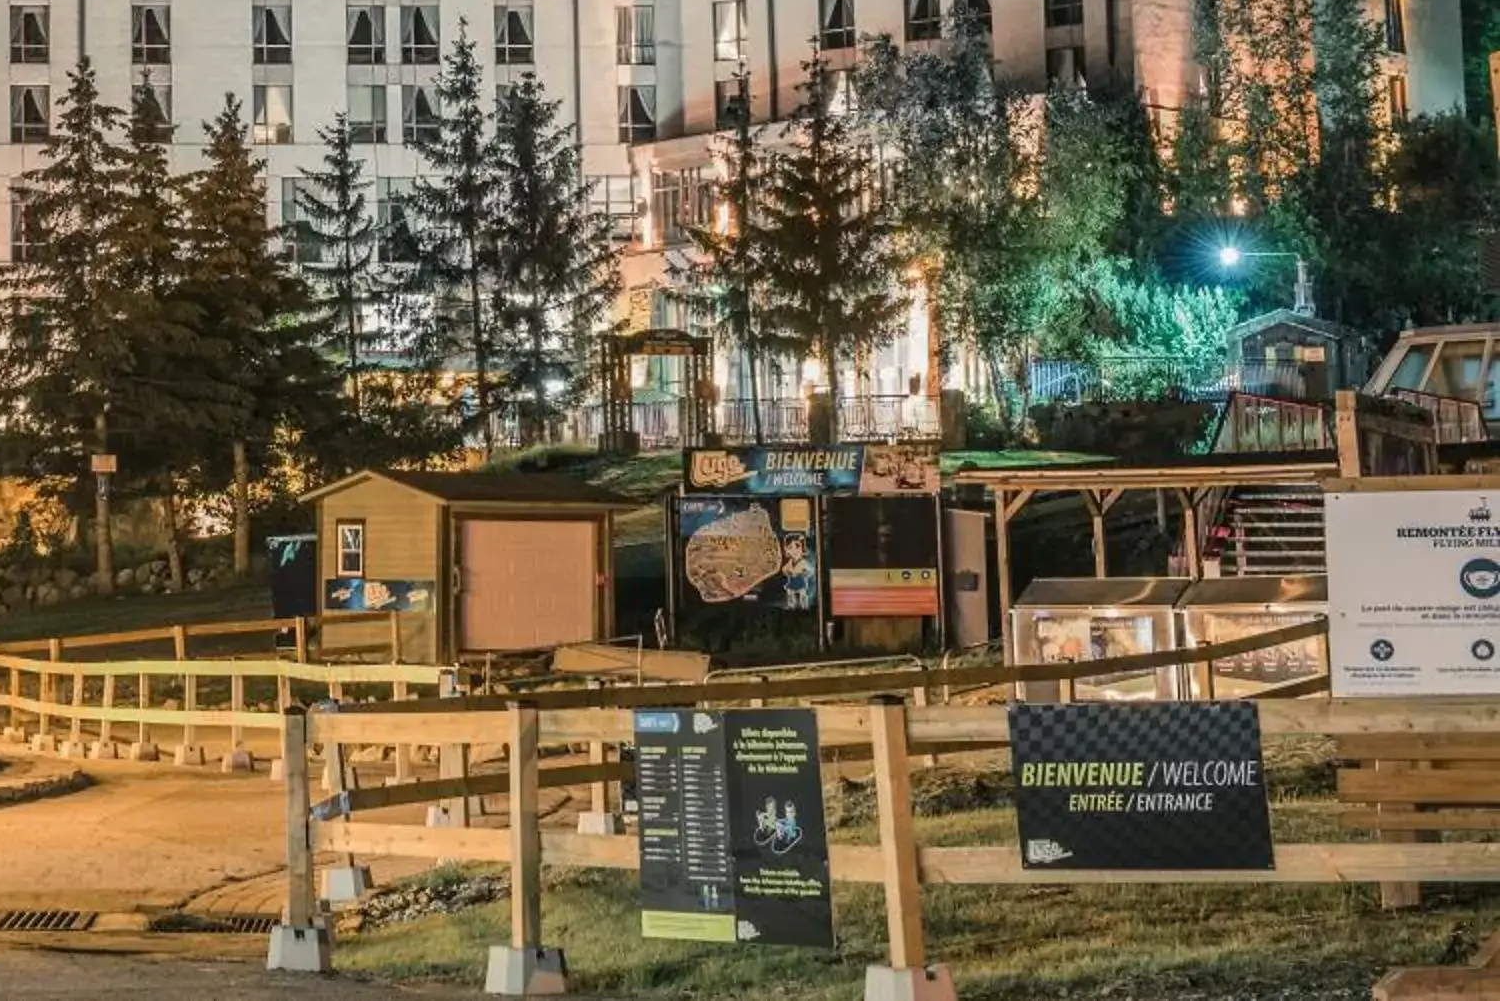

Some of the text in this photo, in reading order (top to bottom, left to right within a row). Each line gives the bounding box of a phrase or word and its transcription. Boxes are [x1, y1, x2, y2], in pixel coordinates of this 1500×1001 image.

[765, 452, 857, 470] BIENVENUE
[772, 472, 824, 486] WELCOME
[1396, 525, 1475, 538] REMONTÉE
[1022, 762, 1144, 787] BIENVENUE
[1162, 761, 1258, 786] WELCOME
[1069, 791, 1123, 812] ENTRÉE
[1136, 794, 1213, 811] ENTRANCE
